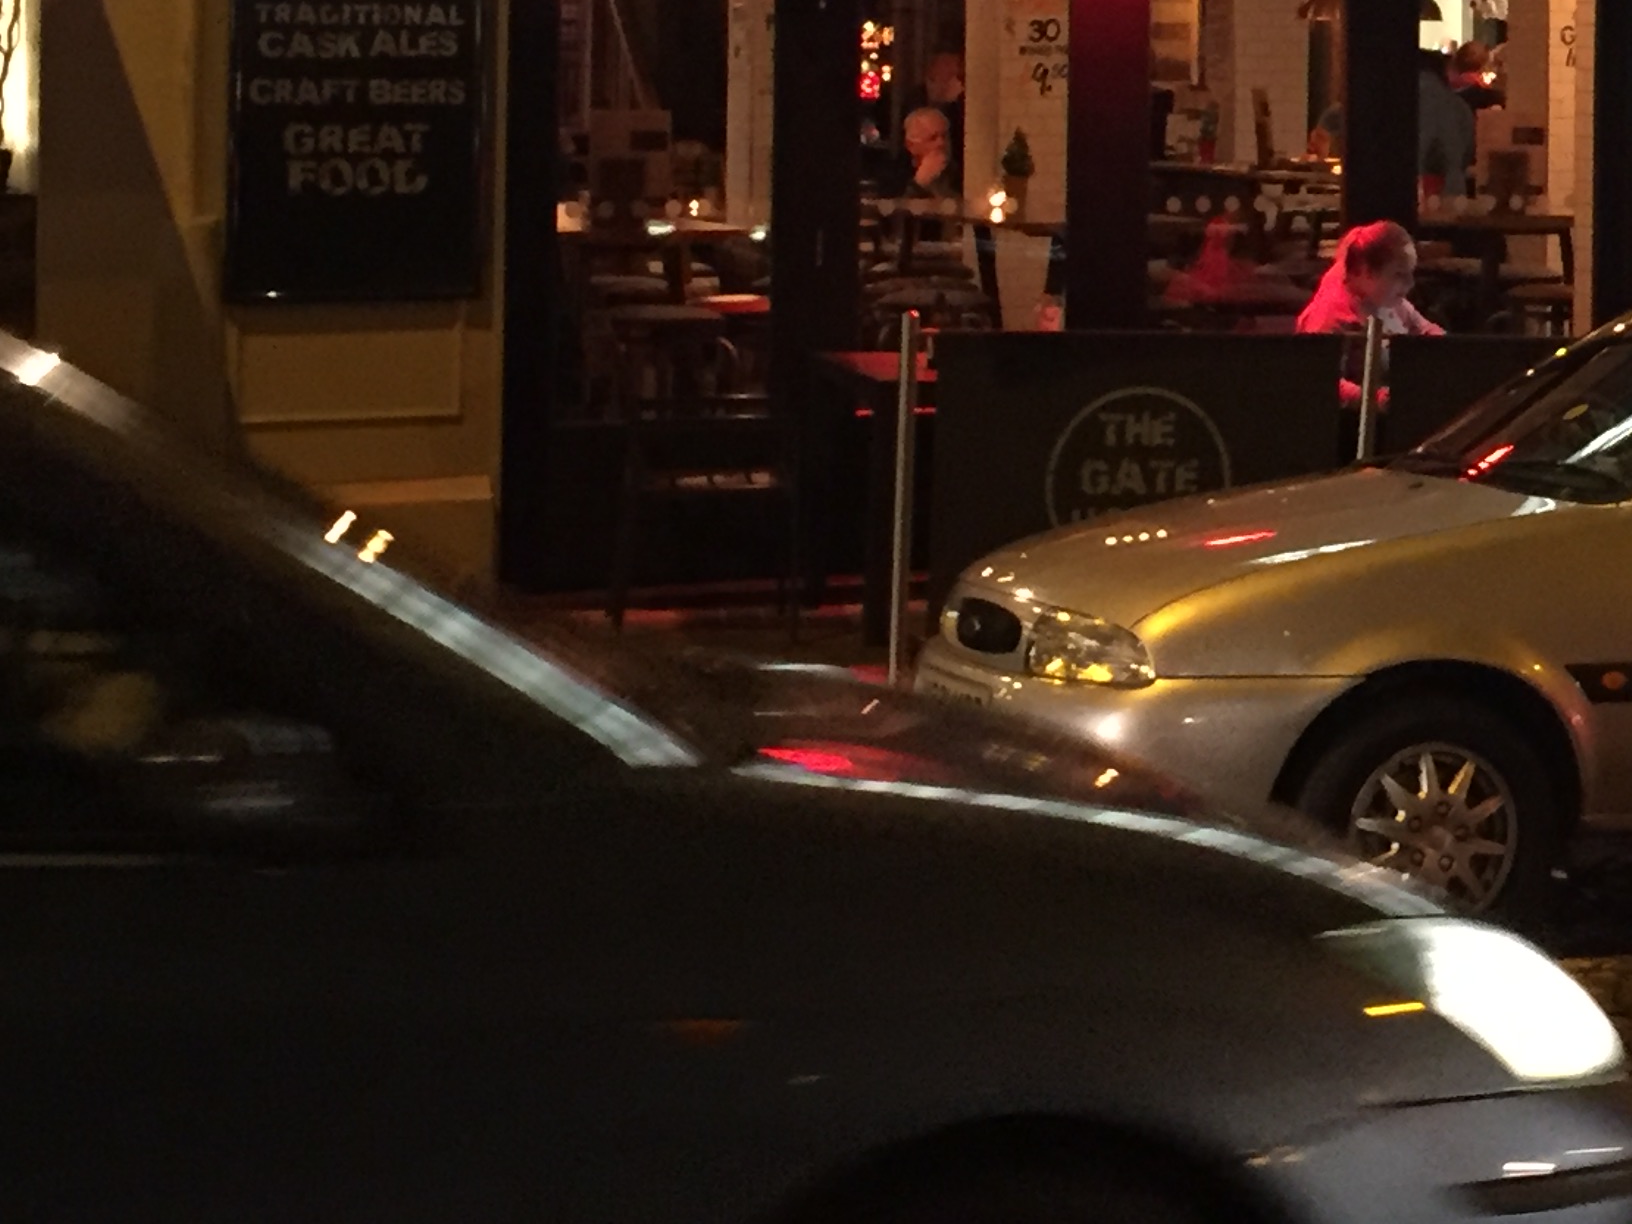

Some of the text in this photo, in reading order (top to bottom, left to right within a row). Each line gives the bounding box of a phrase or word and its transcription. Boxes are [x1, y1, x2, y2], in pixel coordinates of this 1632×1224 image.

[254, 1, 466, 27] TRADITIONAL
[257, 30, 460, 59] CASK ALES
[1027, 18, 1061, 43] 30
[248, 77, 467, 107] CRAFT BEERS
[283, 122, 431, 155] GREAT
[286, 157, 429, 196] FOOD
[1098, 410, 1177, 448] THE
[1080, 456, 1200, 496] GATE
